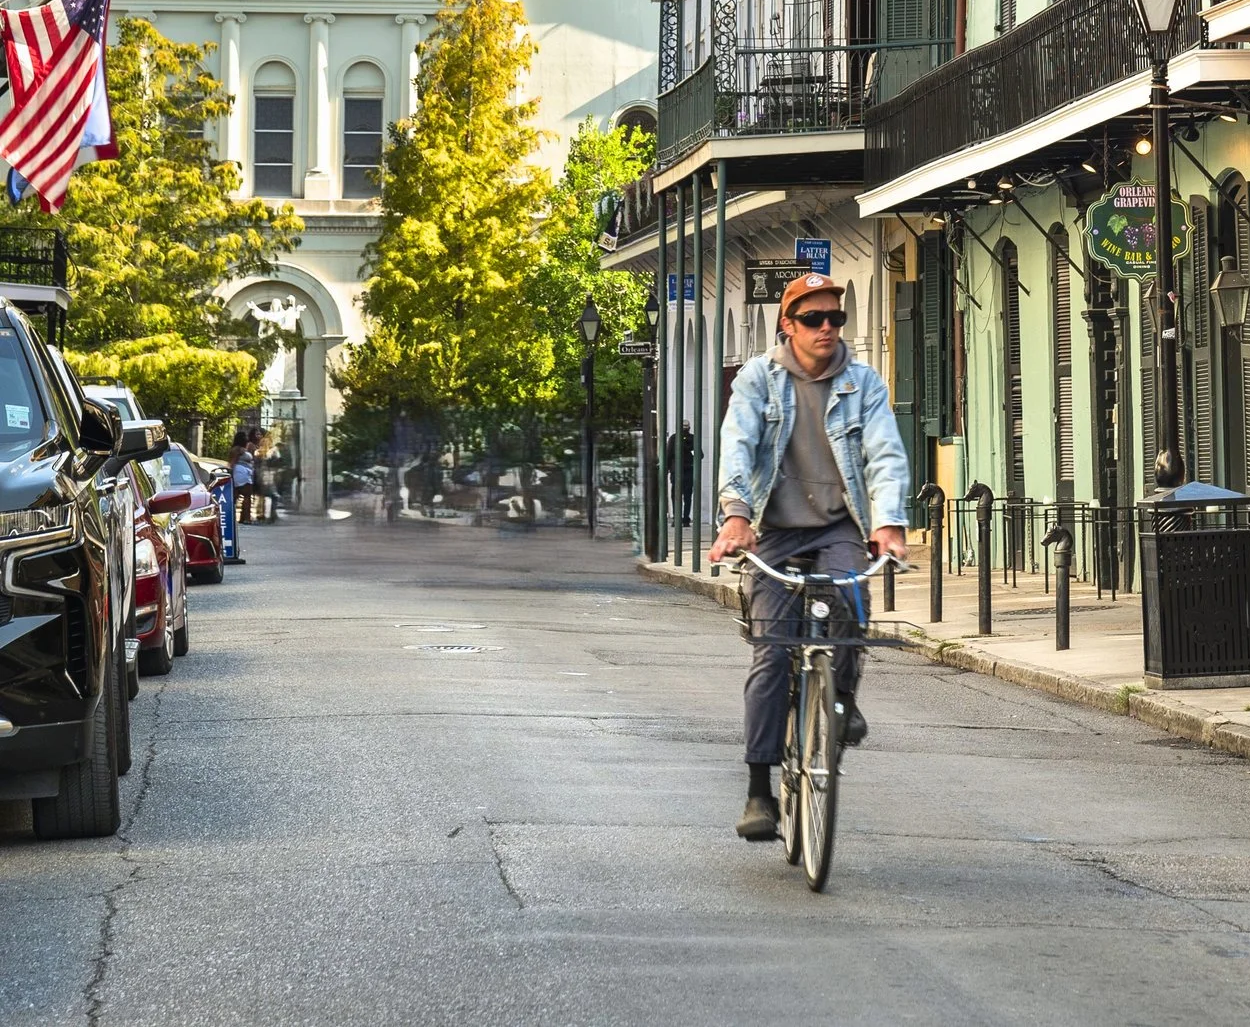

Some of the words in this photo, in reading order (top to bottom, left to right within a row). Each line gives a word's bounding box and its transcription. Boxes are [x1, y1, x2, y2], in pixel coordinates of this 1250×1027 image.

[1113, 197, 1155, 208] GRAPEVIN
[1101, 238, 1122, 257] WINE
[1124, 251, 1142, 261] BAR
[1145, 251, 1152, 261] &
